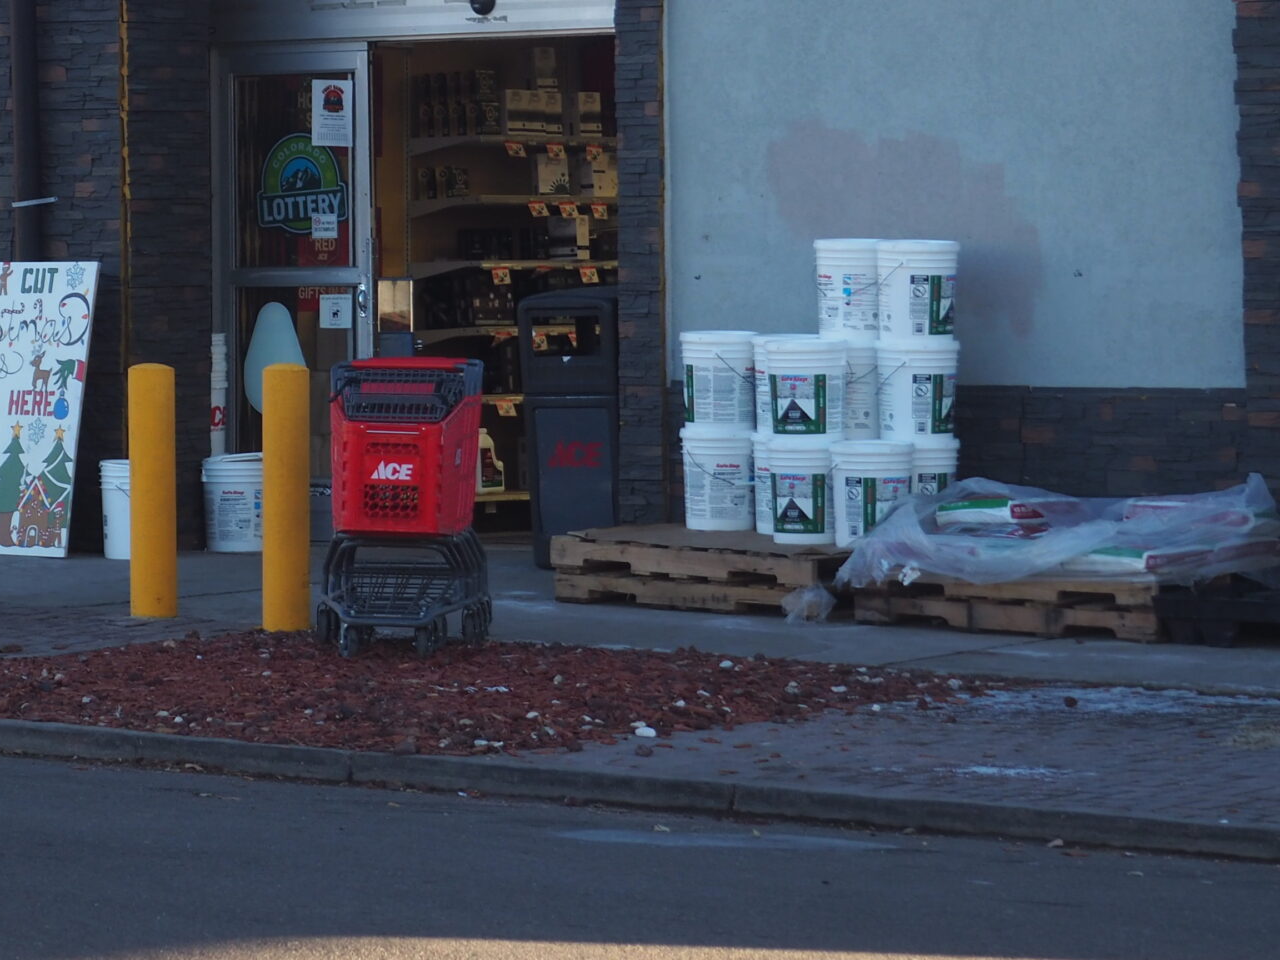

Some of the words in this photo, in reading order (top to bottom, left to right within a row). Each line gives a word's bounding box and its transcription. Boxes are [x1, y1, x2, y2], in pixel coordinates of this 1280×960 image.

[272, 142, 328, 168] COLORADO
[262, 192, 342, 222] LOTTERY
[315, 239, 336, 251] RED
[20, 267, 58, 294] CUT
[8, 390, 56, 417] HERE
[547, 440, 604, 468] ACE
[371, 460, 414, 480] ACE
